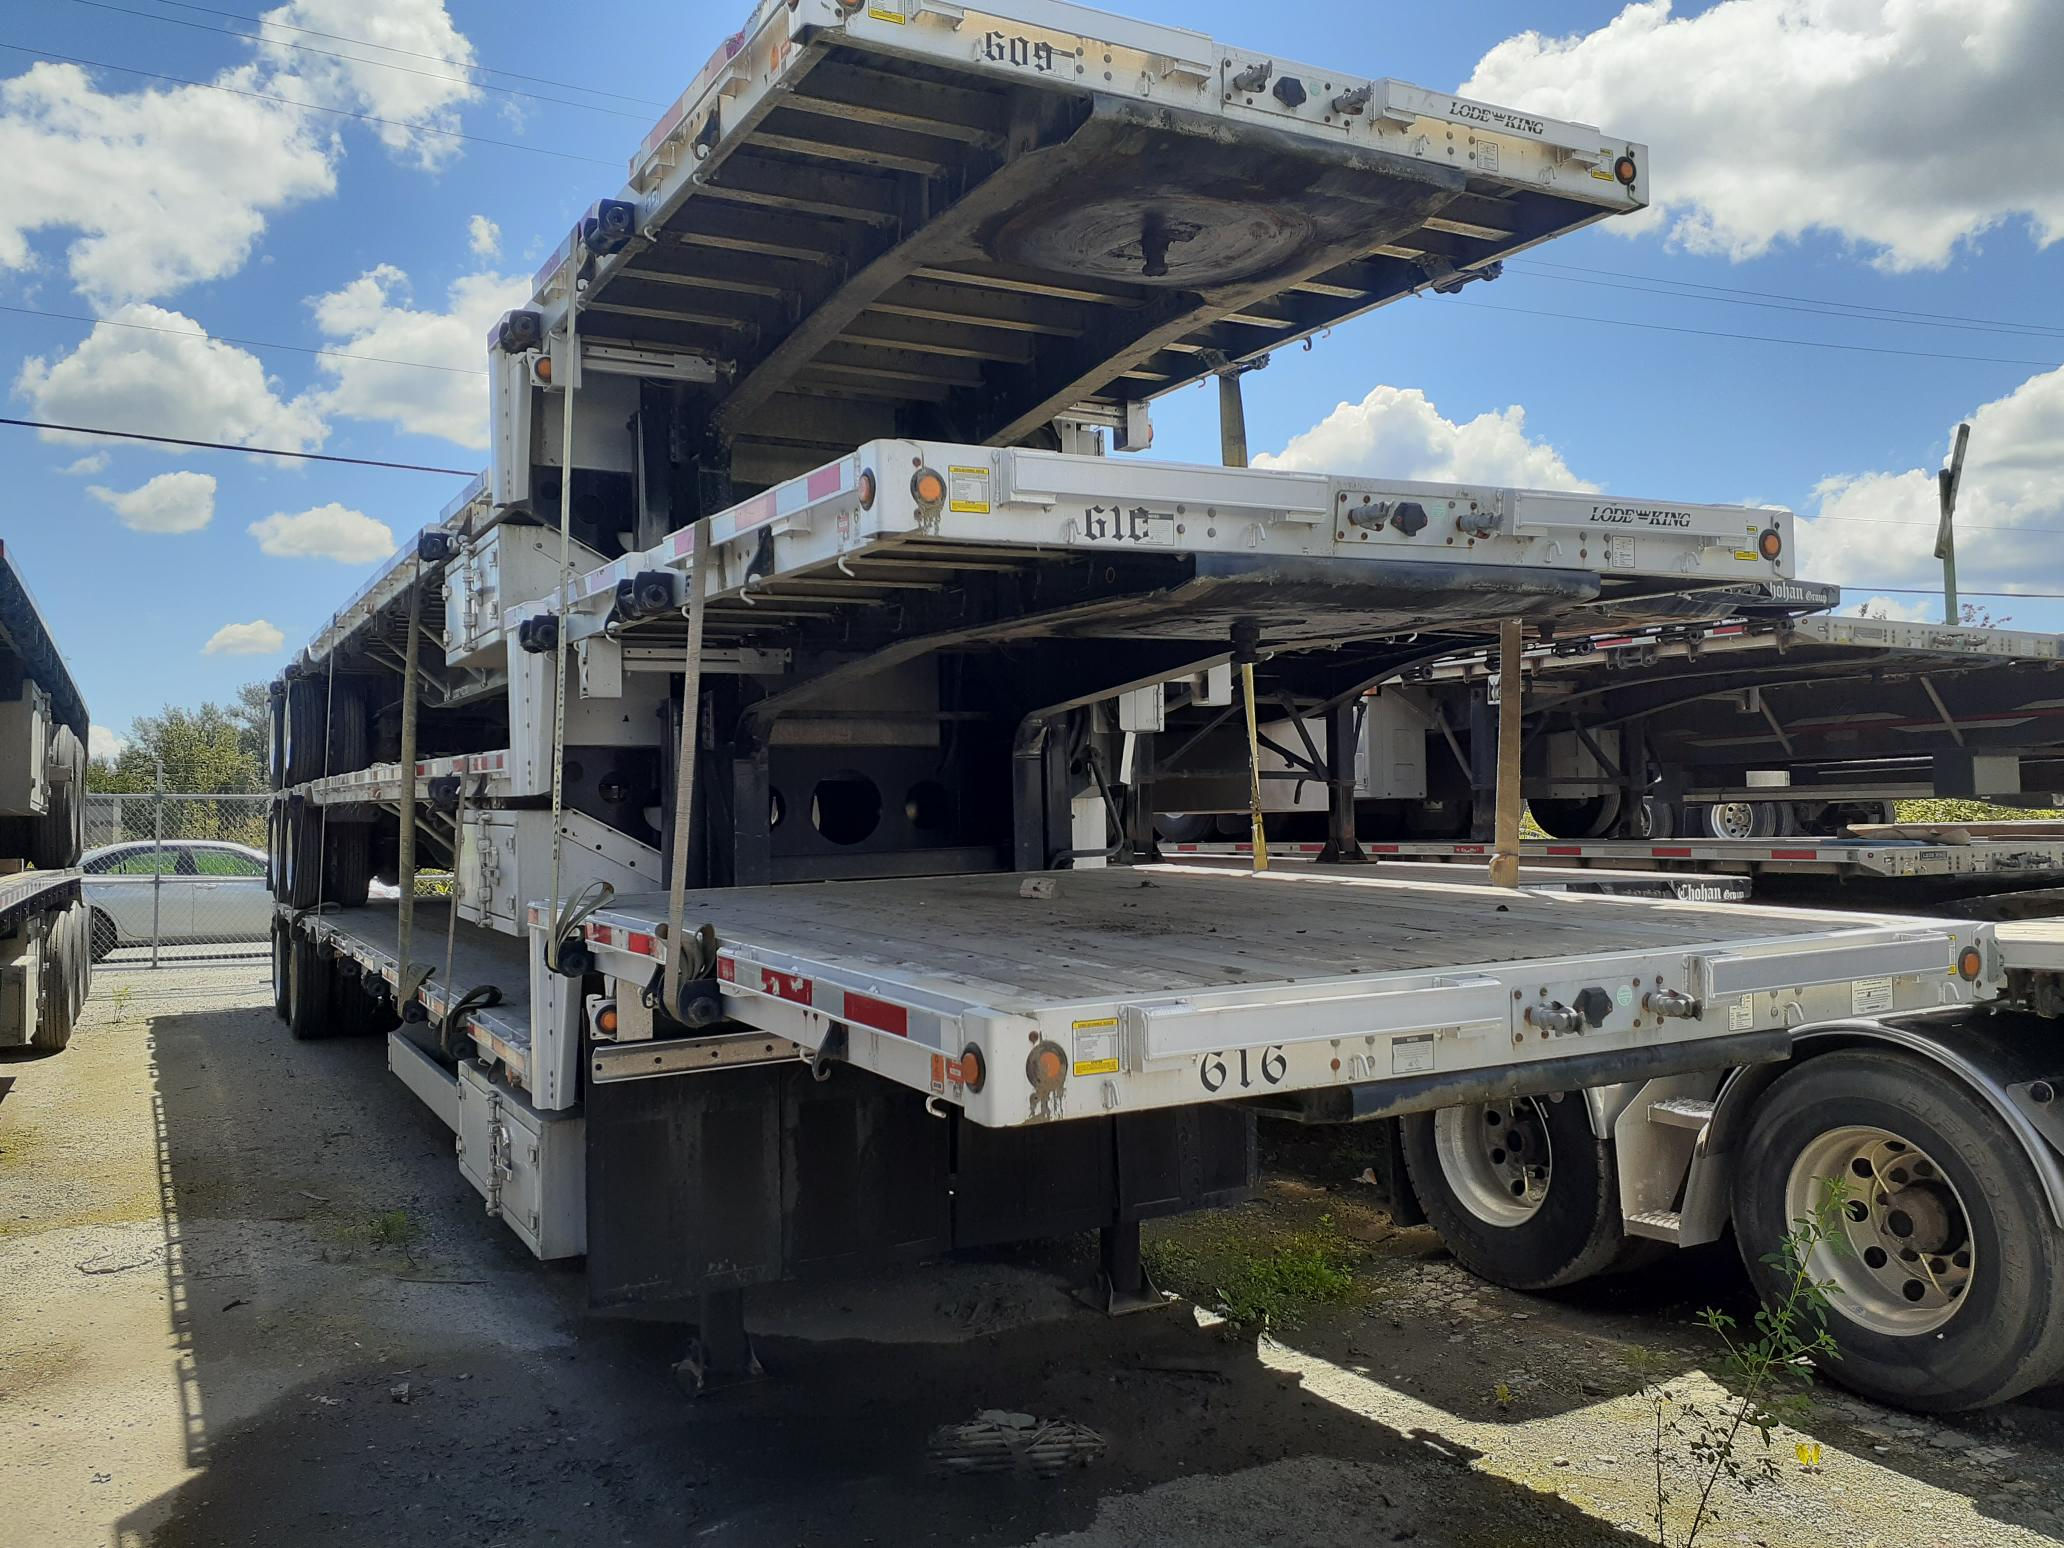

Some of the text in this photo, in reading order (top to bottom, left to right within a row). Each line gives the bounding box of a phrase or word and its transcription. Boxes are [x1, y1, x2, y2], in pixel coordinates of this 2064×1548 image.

[984, 31, 1052, 71] 609
[1449, 102, 1544, 135] LODE KING
[1590, 507, 1691, 527] LODE KING
[1770, 581, 1803, 601] hohan
[1678, 884, 1722, 902] Chohan
[1200, 1045, 1287, 1092] 616
